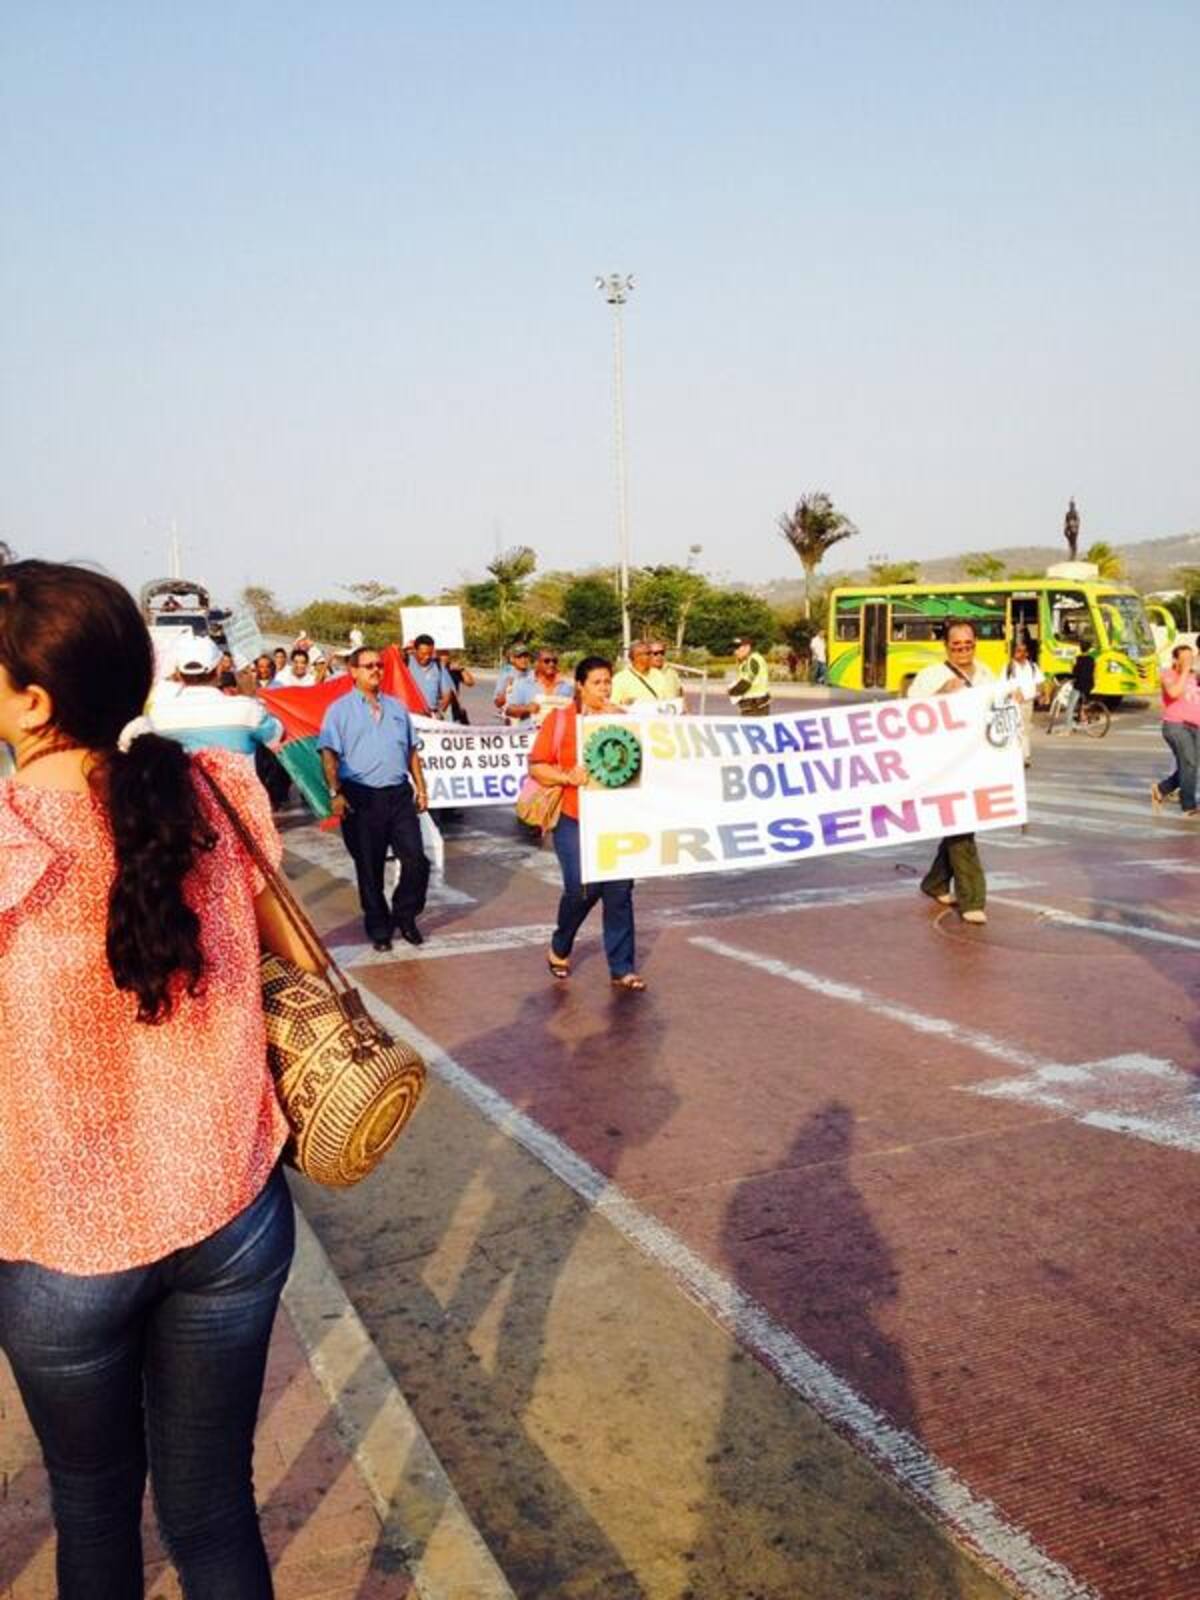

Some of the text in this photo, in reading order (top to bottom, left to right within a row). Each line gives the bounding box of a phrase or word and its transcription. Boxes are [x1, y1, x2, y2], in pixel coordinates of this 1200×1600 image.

[441, 737, 475, 751] QUE
[481, 735, 504, 750] NO
[509, 734, 529, 749] LE
[649, 699, 967, 760] SINTRAELECOL
[462, 756, 472, 769] A
[478, 753, 511, 769] SUS
[721, 749, 909, 802] BOLIVAR
[596, 783, 1019, 872] PRESENTE
